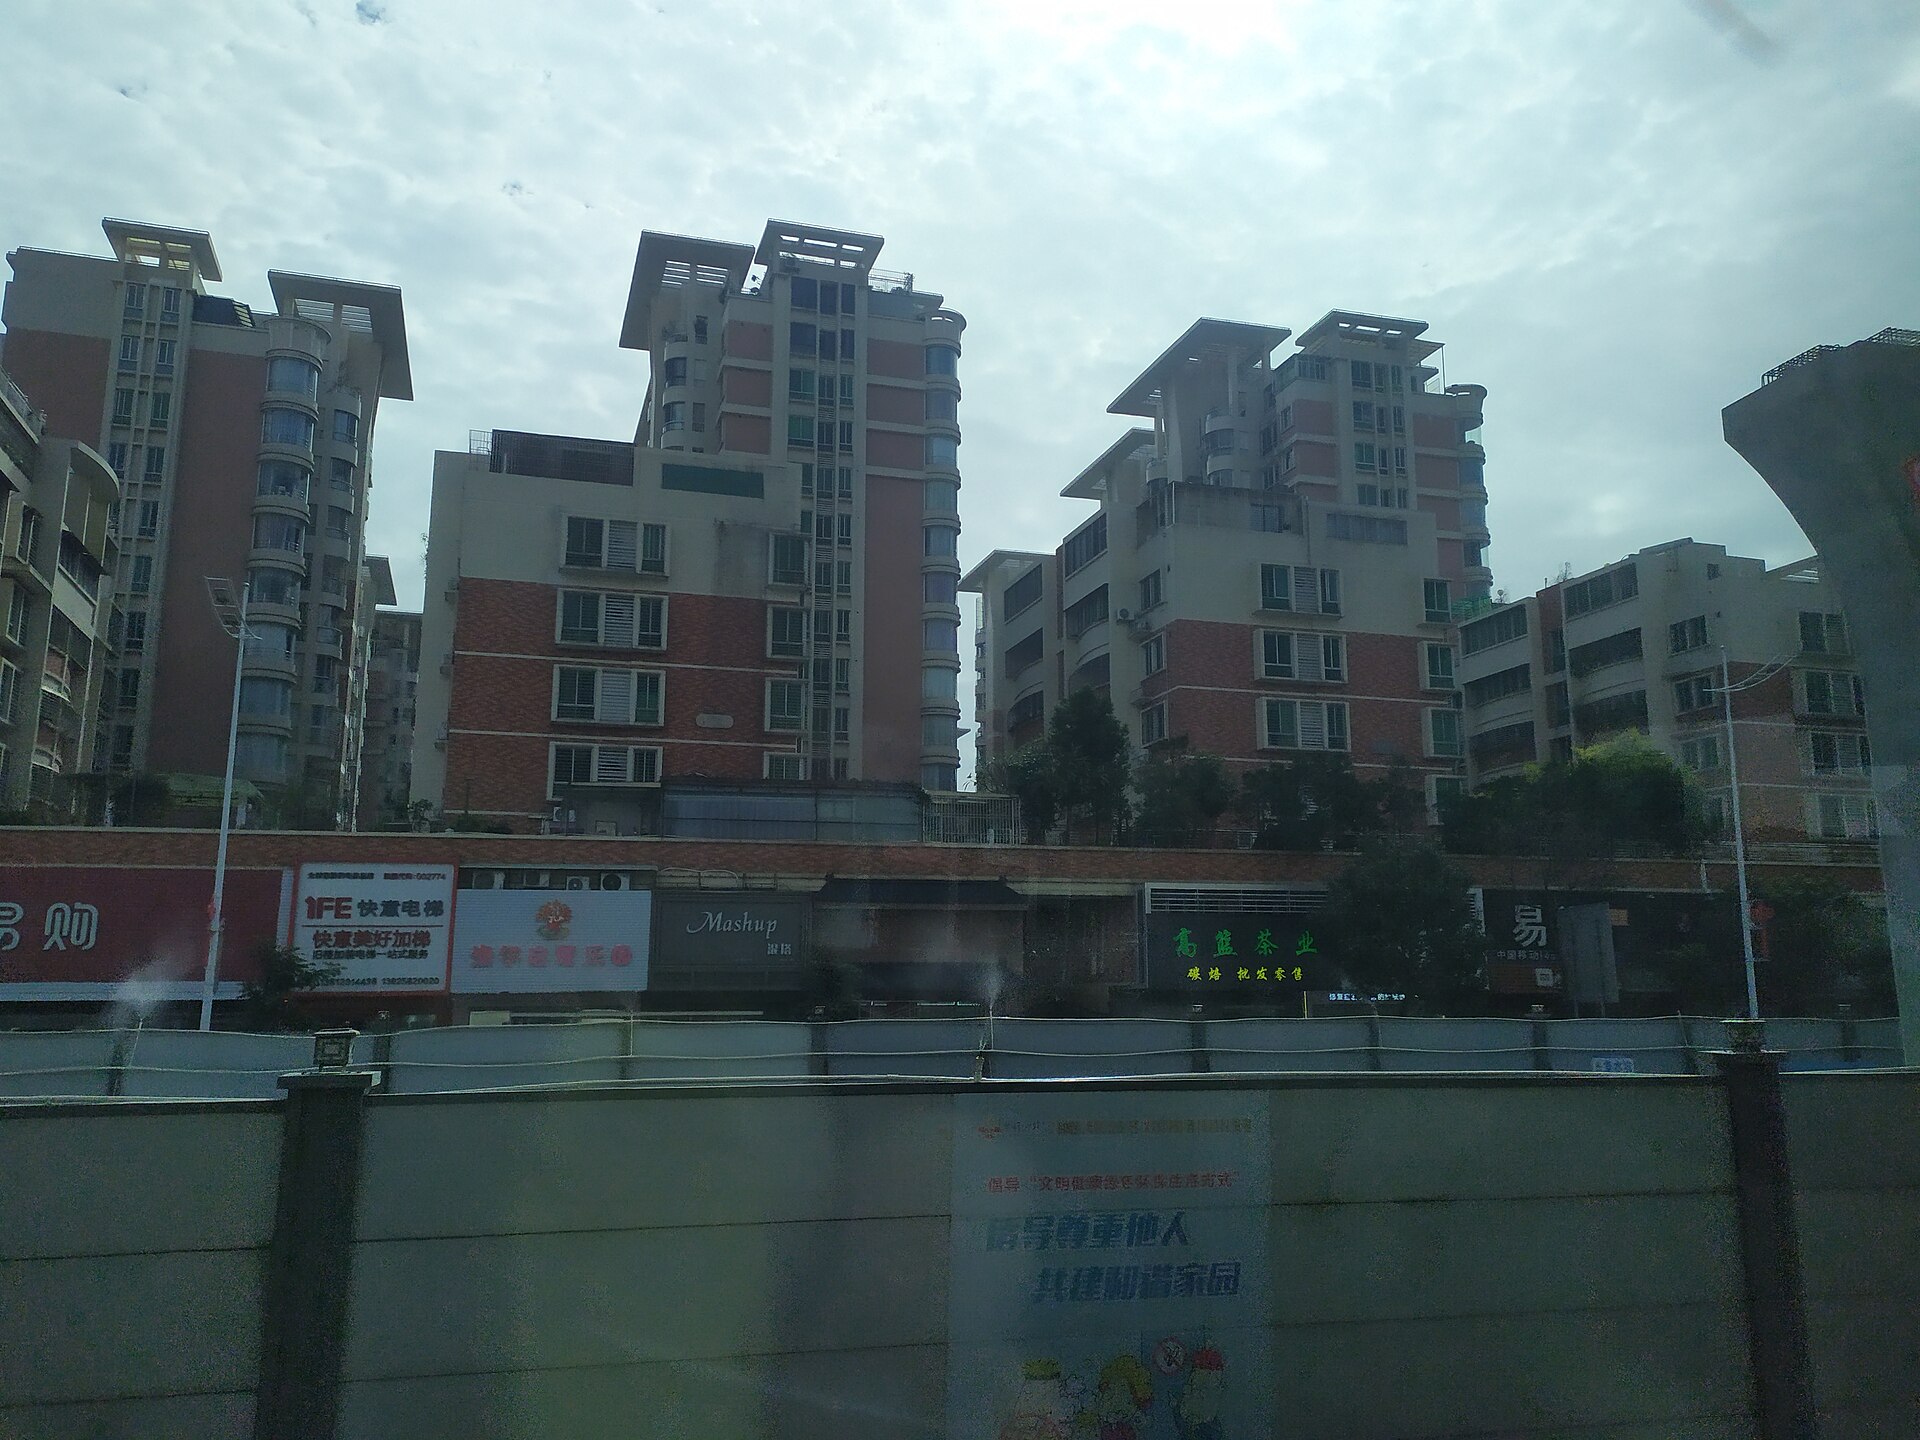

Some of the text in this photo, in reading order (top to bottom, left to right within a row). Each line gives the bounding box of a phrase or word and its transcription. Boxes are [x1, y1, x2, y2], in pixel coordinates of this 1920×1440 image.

[357, 899, 444, 917] 快意电梯
[686, 911, 777, 939] Mashup
[1512, 904, 1548, 947] 易
[1497, 950, 1539, 961] 中国移动
[1186, 966, 1303, 982] 碳焙 批发零售
